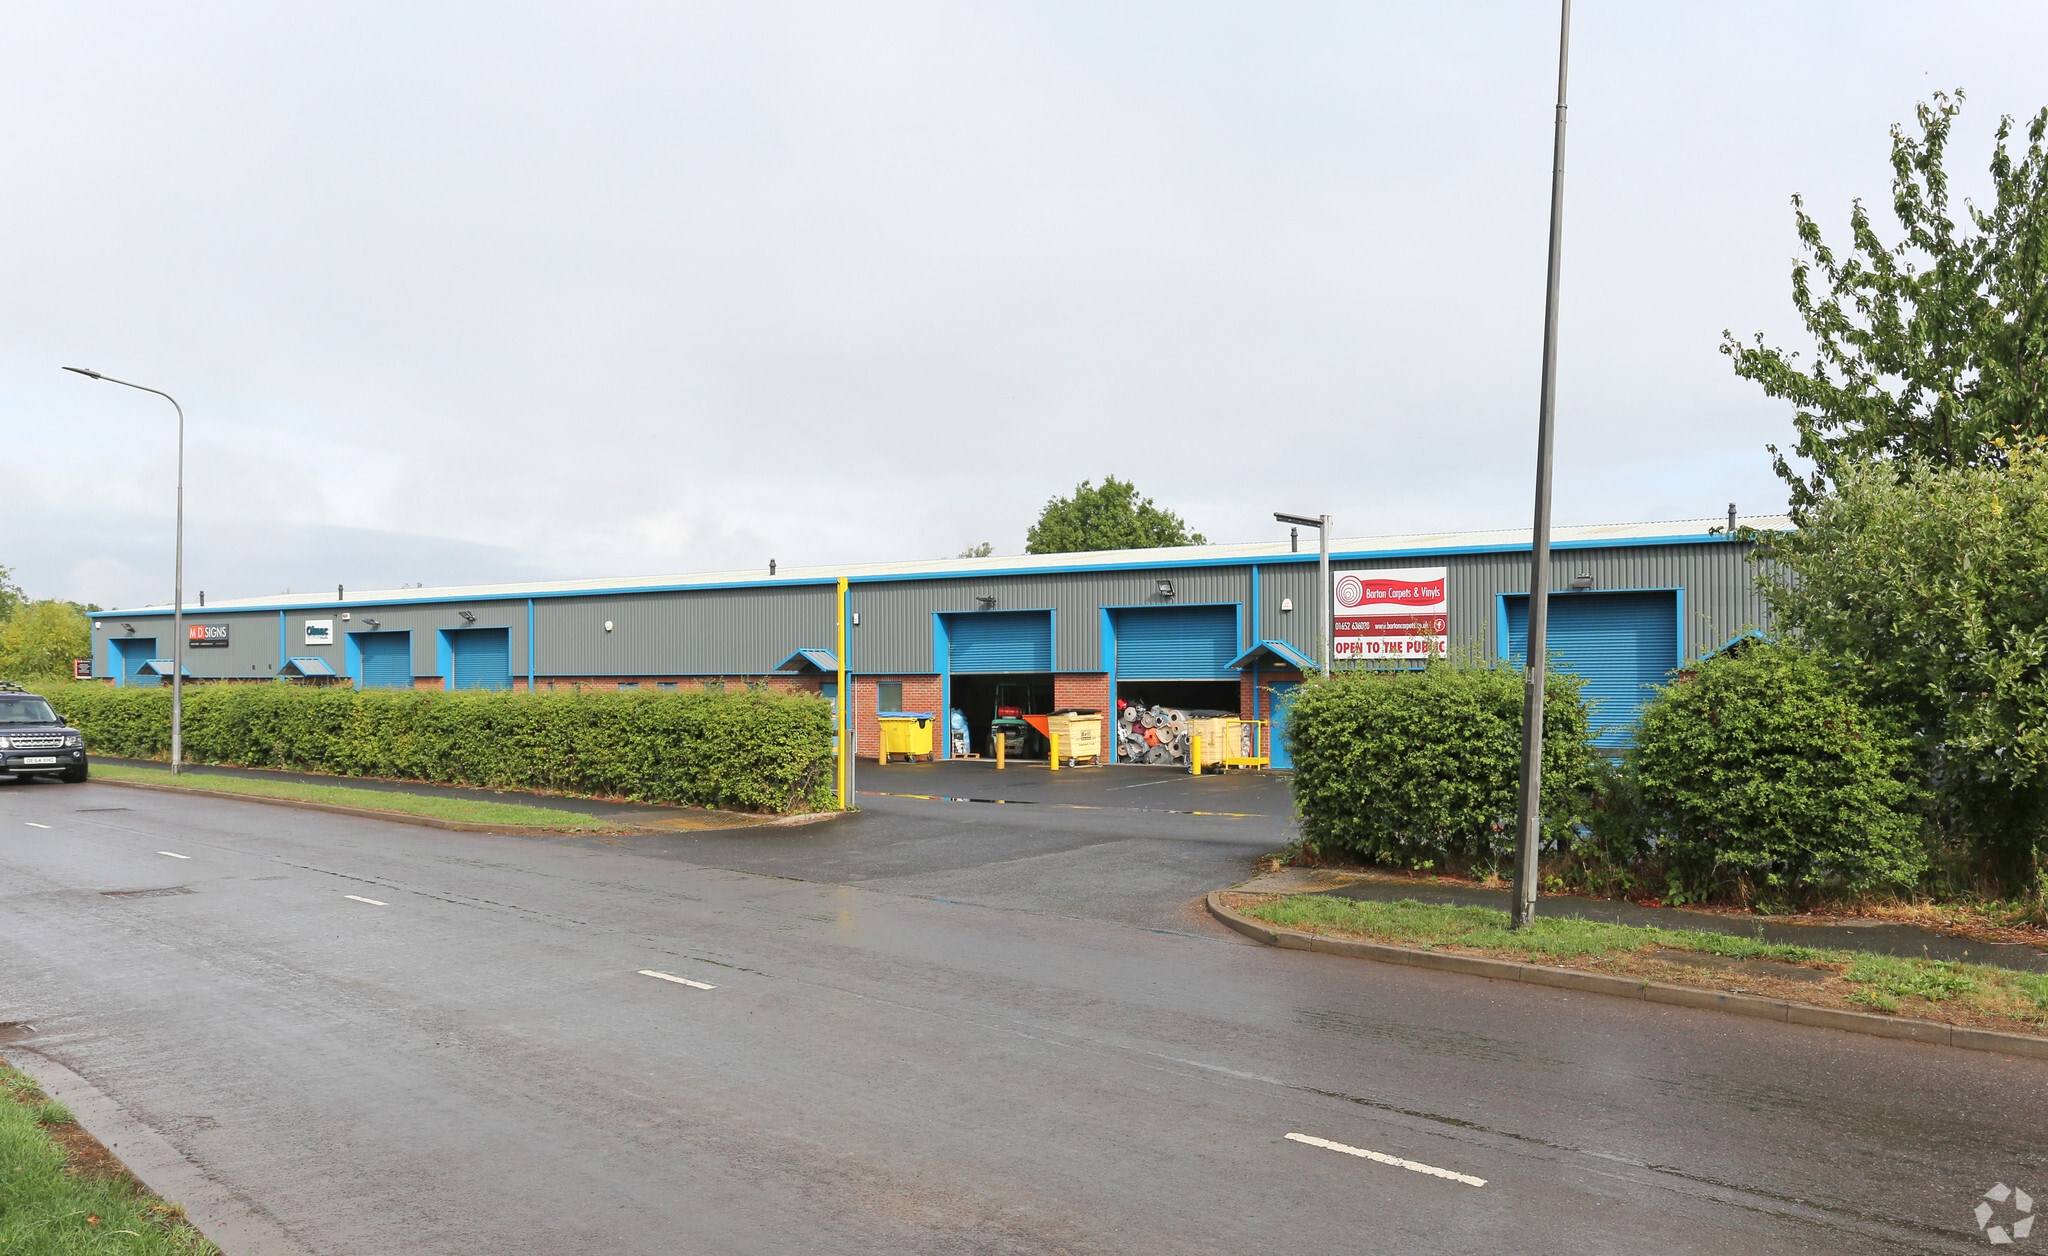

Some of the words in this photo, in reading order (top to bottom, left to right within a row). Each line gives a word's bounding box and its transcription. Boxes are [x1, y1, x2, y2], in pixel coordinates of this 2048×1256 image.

[1366, 588, 1387, 599] Barton
[1388, 587, 1412, 600] Carpets
[1413, 586, 1420, 598] &
[1420, 586, 1441, 599] Vinyls
[204, 626, 227, 638] SIGNS
[1335, 622, 1350, 630] 01652
[1335, 642, 1363, 654] OPEN
[1366, 641, 1380, 654] TO
[1383, 641, 1403, 653] THE
[1406, 641, 1445, 653] PUBIC
